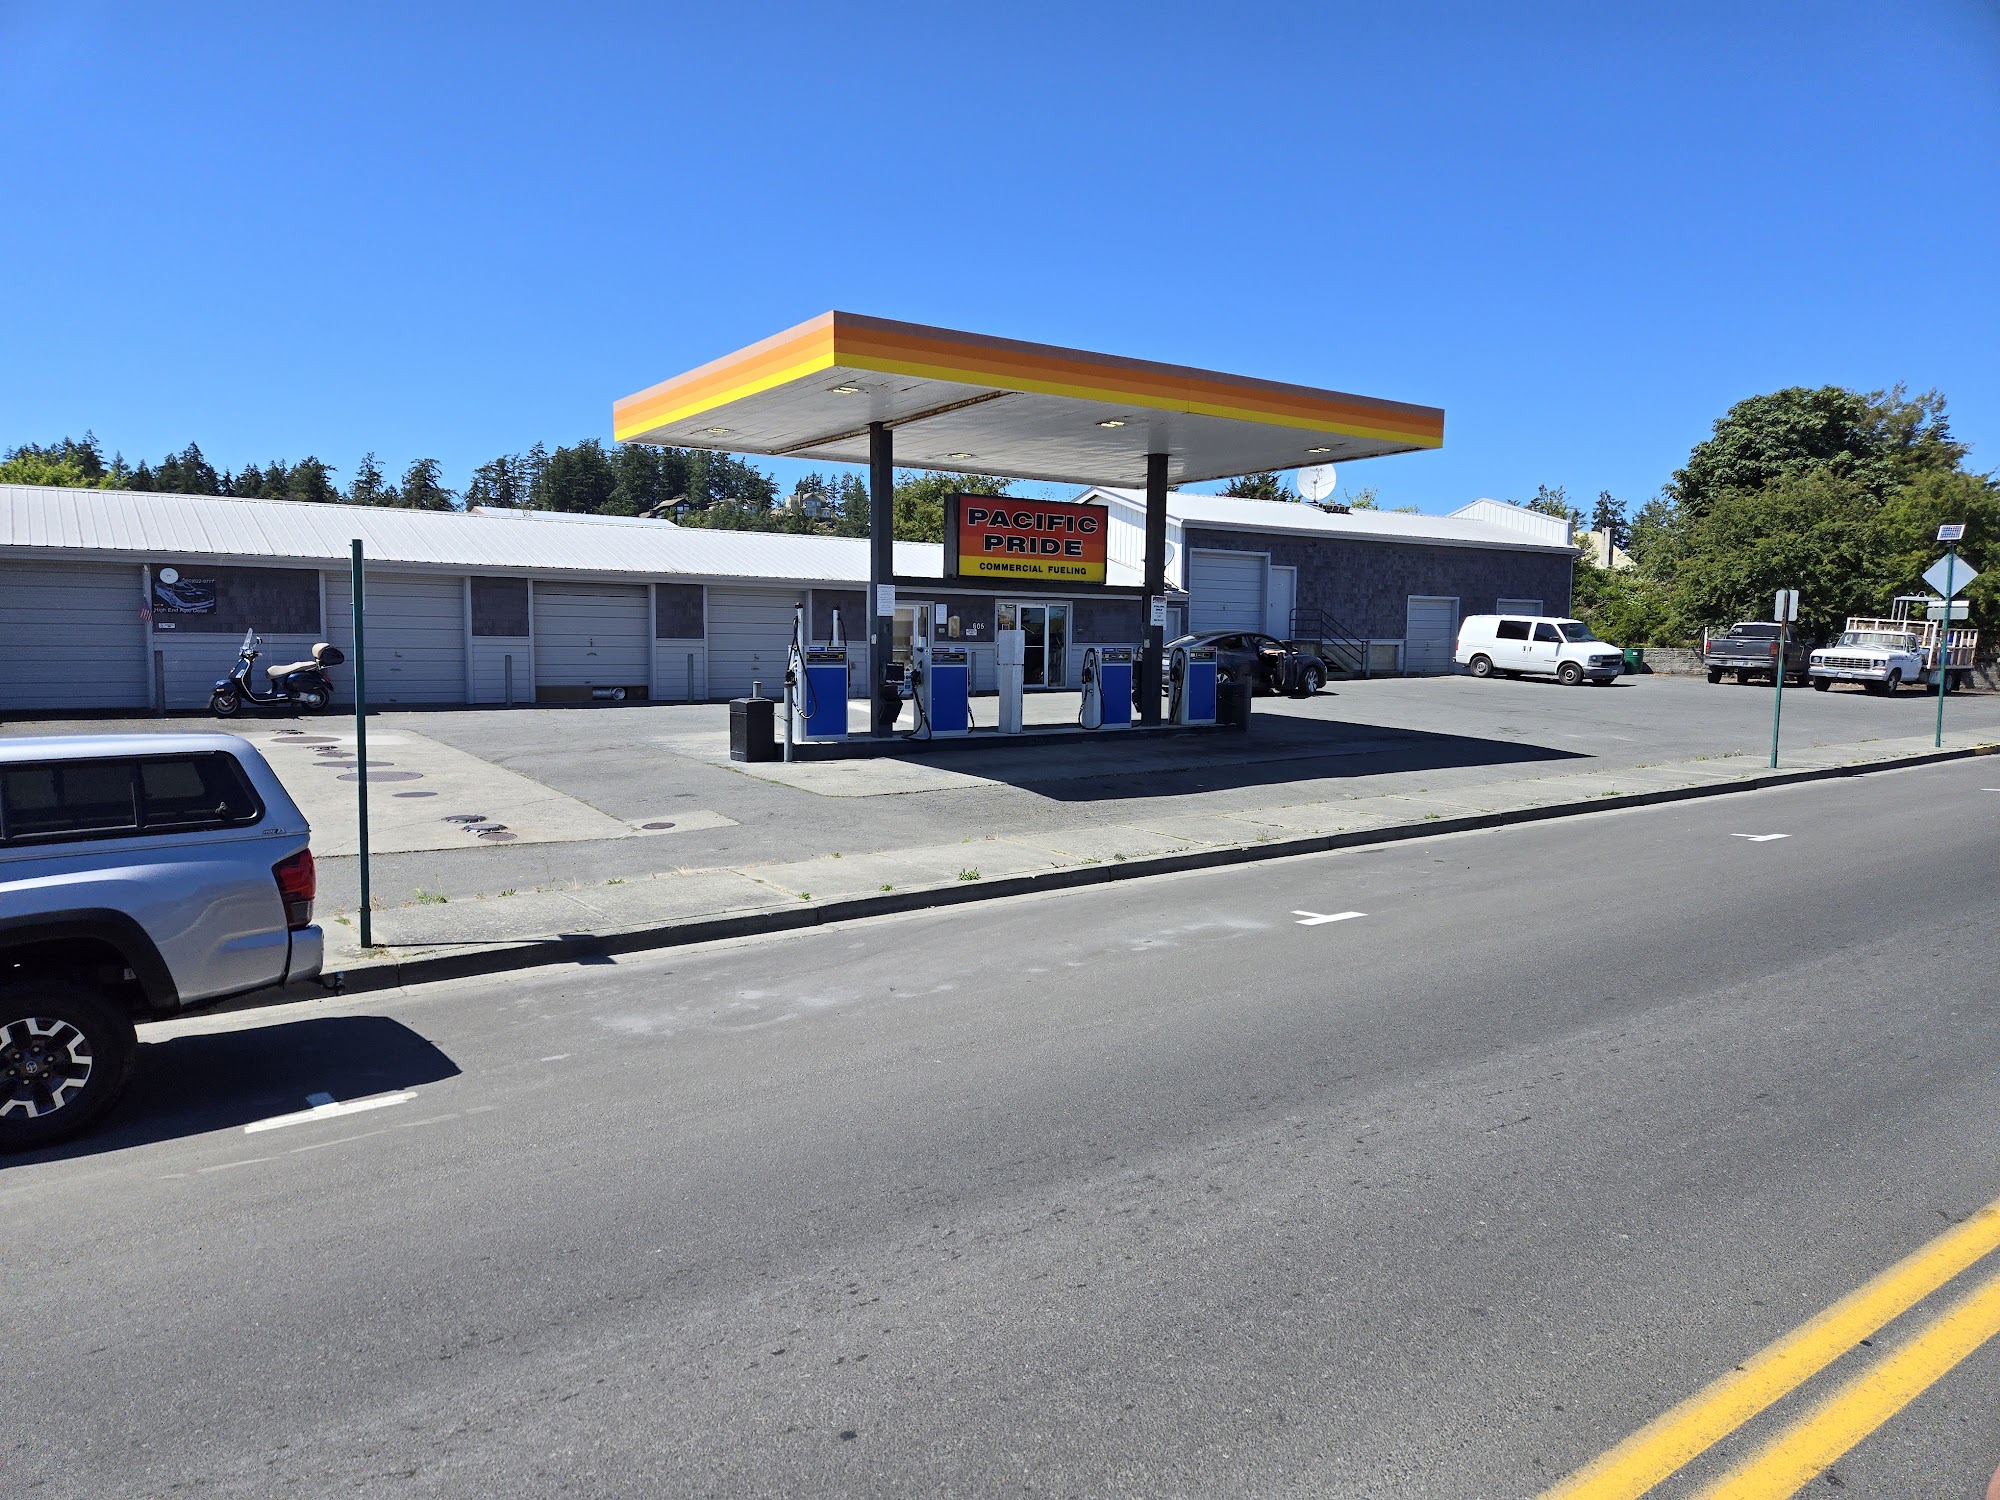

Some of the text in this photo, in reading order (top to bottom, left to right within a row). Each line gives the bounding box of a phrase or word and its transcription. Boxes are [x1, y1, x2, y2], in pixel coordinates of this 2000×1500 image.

[967, 507, 1099, 534] PACIFIC
[983, 533, 1083, 557] PRIDE
[979, 562, 1087, 575] COMMERCIAL FUELING
